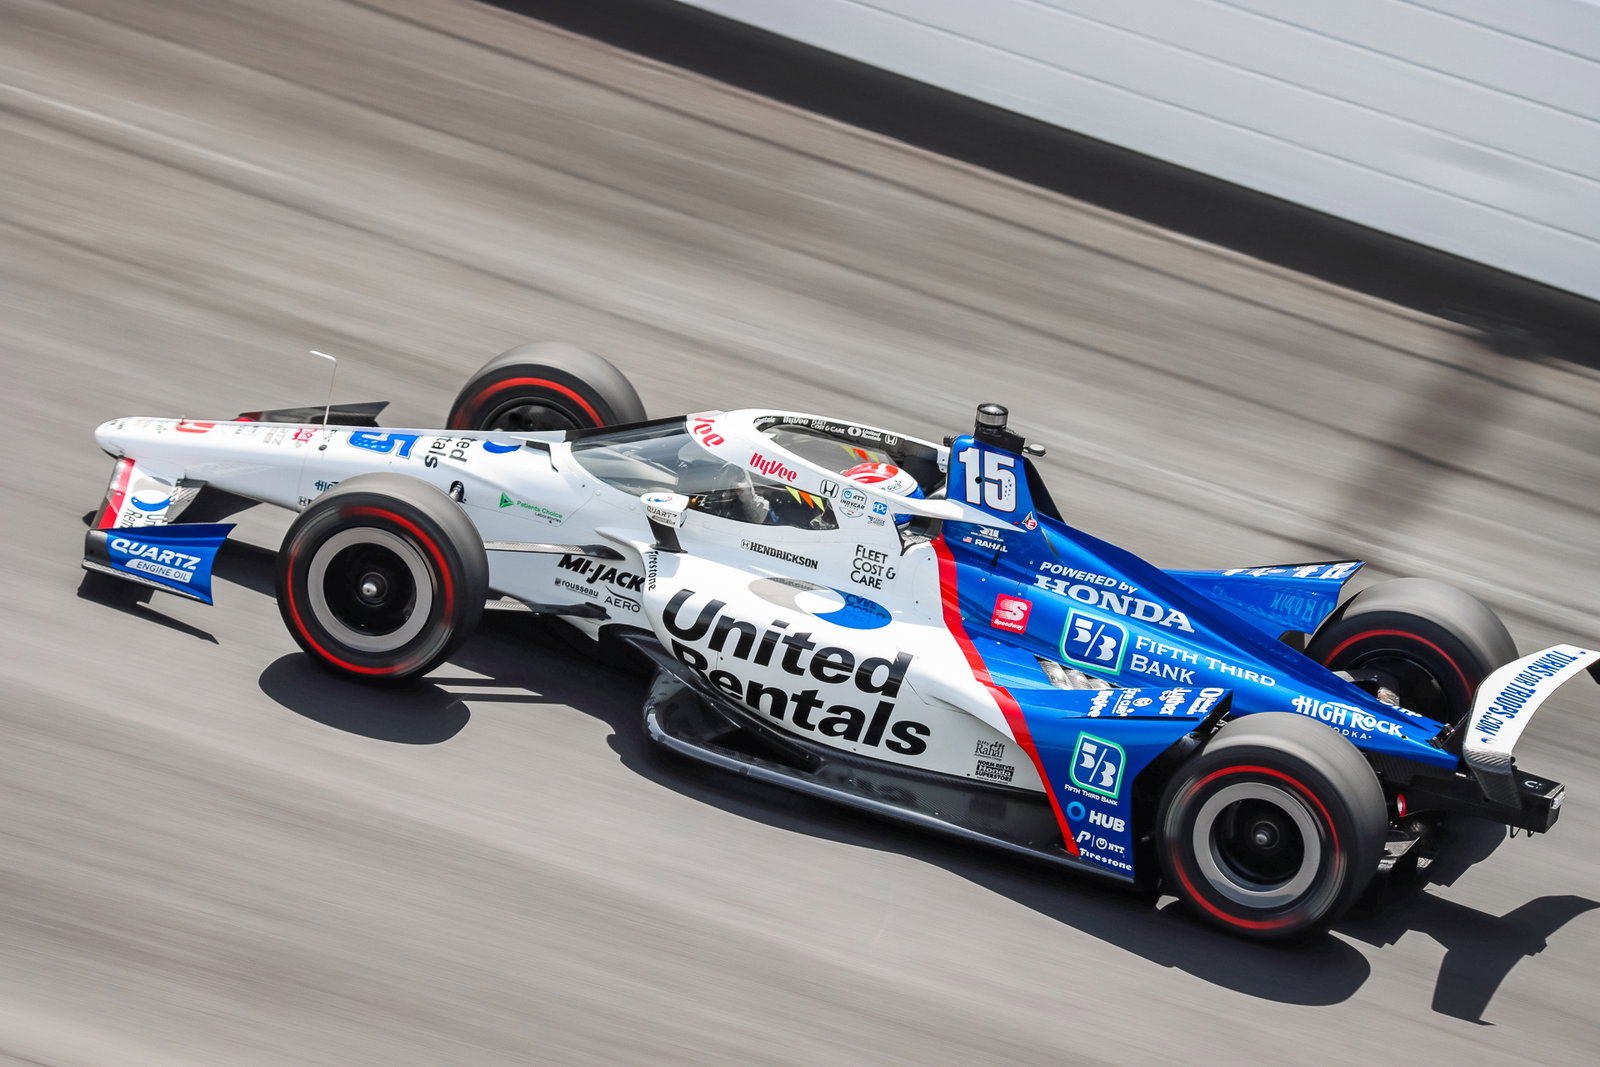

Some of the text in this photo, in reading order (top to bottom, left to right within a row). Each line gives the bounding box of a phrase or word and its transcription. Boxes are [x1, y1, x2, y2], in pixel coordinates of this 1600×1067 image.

[830, 426, 846, 434] CARE
[749, 452, 797, 482] HyVee
[958, 446, 1017, 512] 15
[541, 507, 564, 519] Choice
[840, 498, 866, 510] INDYCAR
[110, 538, 202, 571] QUARTZ
[749, 541, 819, 570] HENDRICKSON
[855, 544, 889, 565] FLEET
[974, 538, 1009, 553] RAHAL
[136, 560, 189, 582] ENGINE OIL
[557, 553, 647, 593] MI-JACK
[645, 550, 660, 592] Firestone
[850, 570, 883, 590] CARE
[852, 557, 896, 580] COST &
[1039, 561, 1139, 594] POWERED by
[561, 579, 599, 598] rousseau
[604, 595, 641, 613] AERO
[1033, 574, 1196, 634] HONDA
[993, 618, 1025, 631] Speedway
[662, 588, 914, 699] United
[1129, 653, 1197, 685] BANK
[1135, 635, 1277, 687] FIFTH THIRD
[1528, 650, 1579, 677] TURNS
[1513, 669, 1543, 687] FOR
[671, 639, 931, 756] Rentals
[1291, 695, 1348, 726] HIGH
[1349, 711, 1404, 738] ROCK
[1329, 725, 1368, 740] ODKA
[975, 742, 1006, 758] Rahal
[975, 770, 1013, 782] SUPERSTORE
[976, 764, 1014, 777] Honda
[977, 759, 1015, 771] NORM REEVES
[1064, 783, 1119, 807] FIFTH THIRD BANK
[1088, 809, 1126, 833] HUB
[1079, 847, 1133, 872] Firestone
[1107, 843, 1126, 855] NTT
